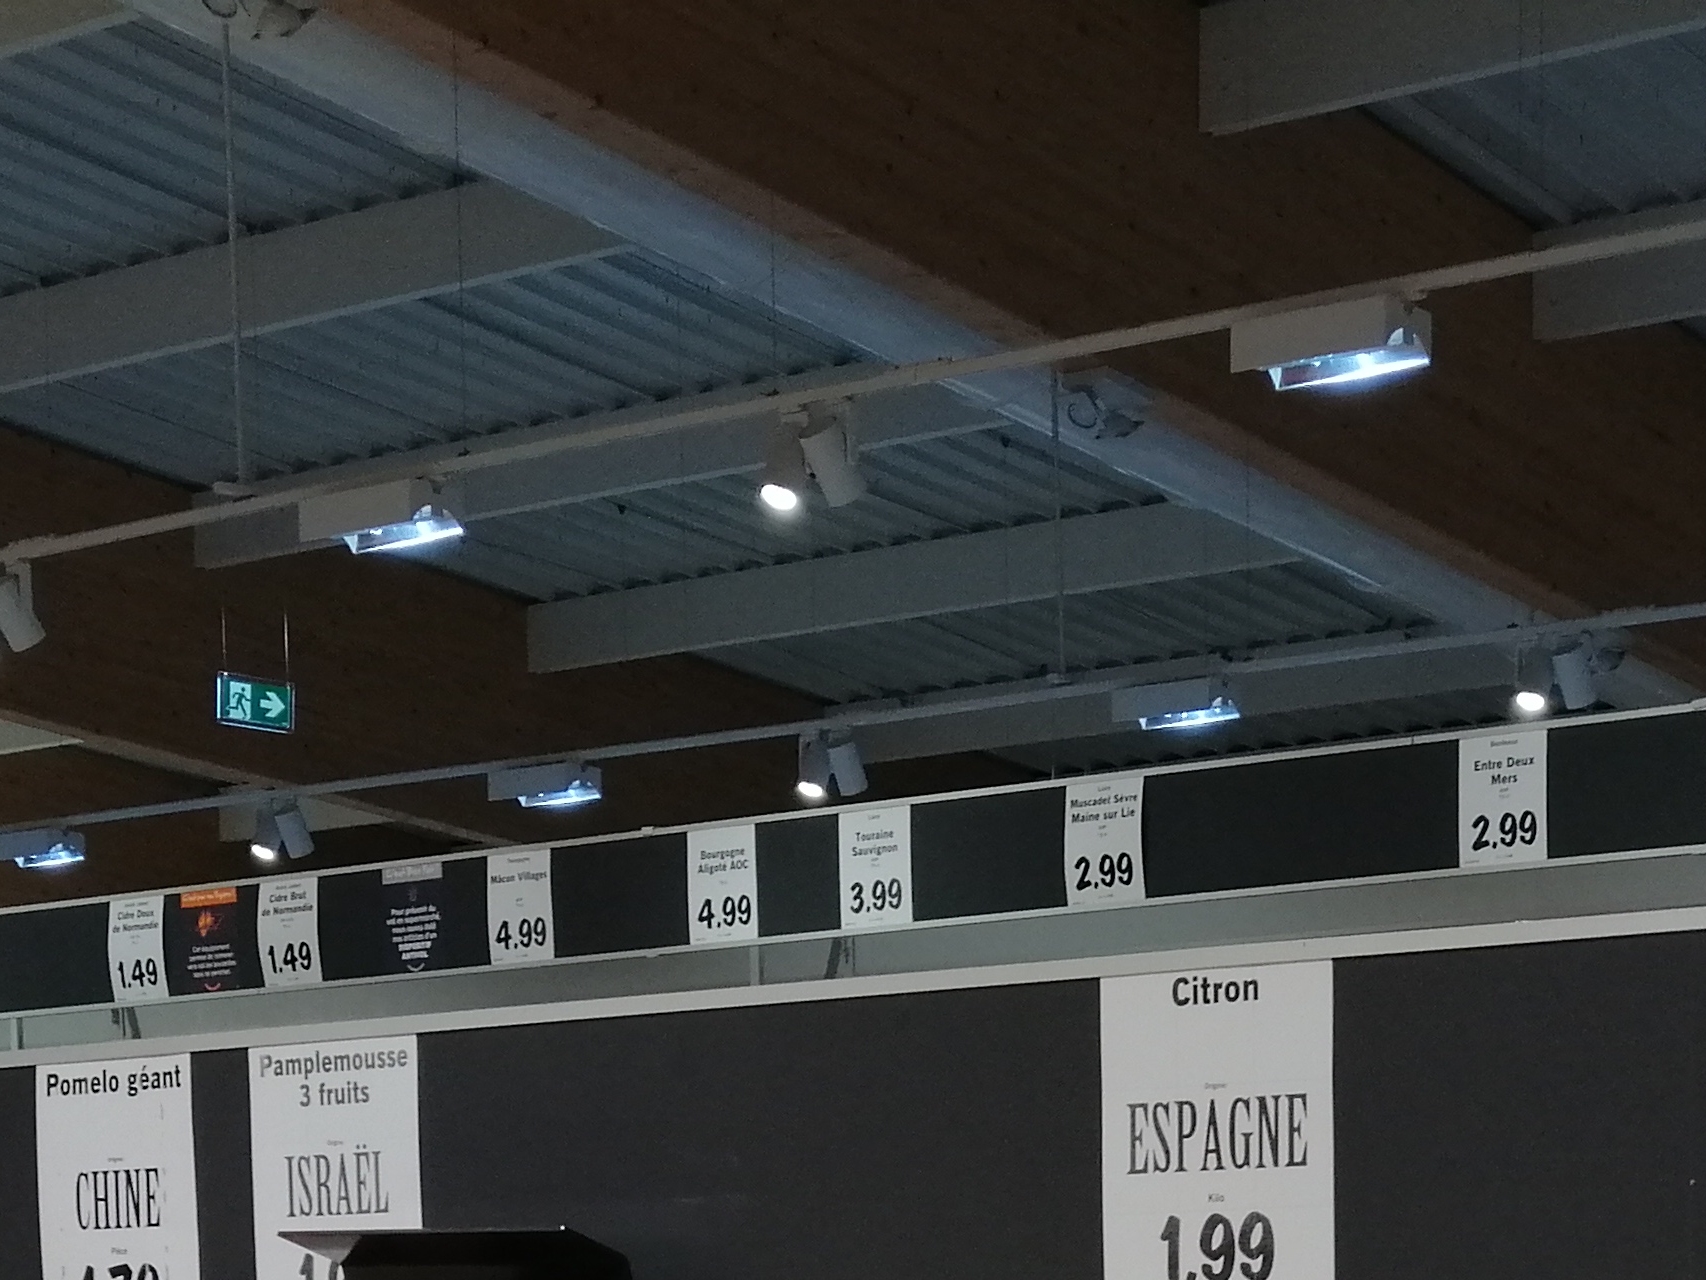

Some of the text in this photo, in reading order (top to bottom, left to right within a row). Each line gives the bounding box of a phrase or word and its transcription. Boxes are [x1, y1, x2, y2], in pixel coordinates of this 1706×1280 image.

[1473, 754, 1535, 772] Entre Deux
[1491, 771, 1518, 786] Mers
[1071, 806, 1136, 824] Maine sur Lie
[1471, 810, 1538, 851] 2.99
[851, 842, 898, 858] Sauvignon
[855, 828, 894, 842] Touraine
[700, 846, 745, 863] Bourgogne
[1074, 850, 1134, 891] 2.99
[269, 890, 307, 904] Cidre Brut
[272, 902, 313, 916] Normandie
[850, 877, 902, 914] 3.99
[117, 908, 155, 920] Cidre Doux
[123, 920, 159, 933] Normandie
[697, 894, 751, 930] 4.99
[496, 916, 546, 950] 4.99
[117, 958, 158, 989] 1.49
[267, 941, 312, 975] 1.49
[1172, 975, 1259, 1007] Citron
[259, 1047, 408, 1078] Pamplemousse
[47, 1064, 181, 1098] Pomelo géant
[299, 1081, 370, 1107] 3 fruits
[1127, 1092, 1308, 1175] ESPAGNE
[284, 1144, 389, 1218] ISRAËL
[75, 1167, 161, 1230] CHINE
